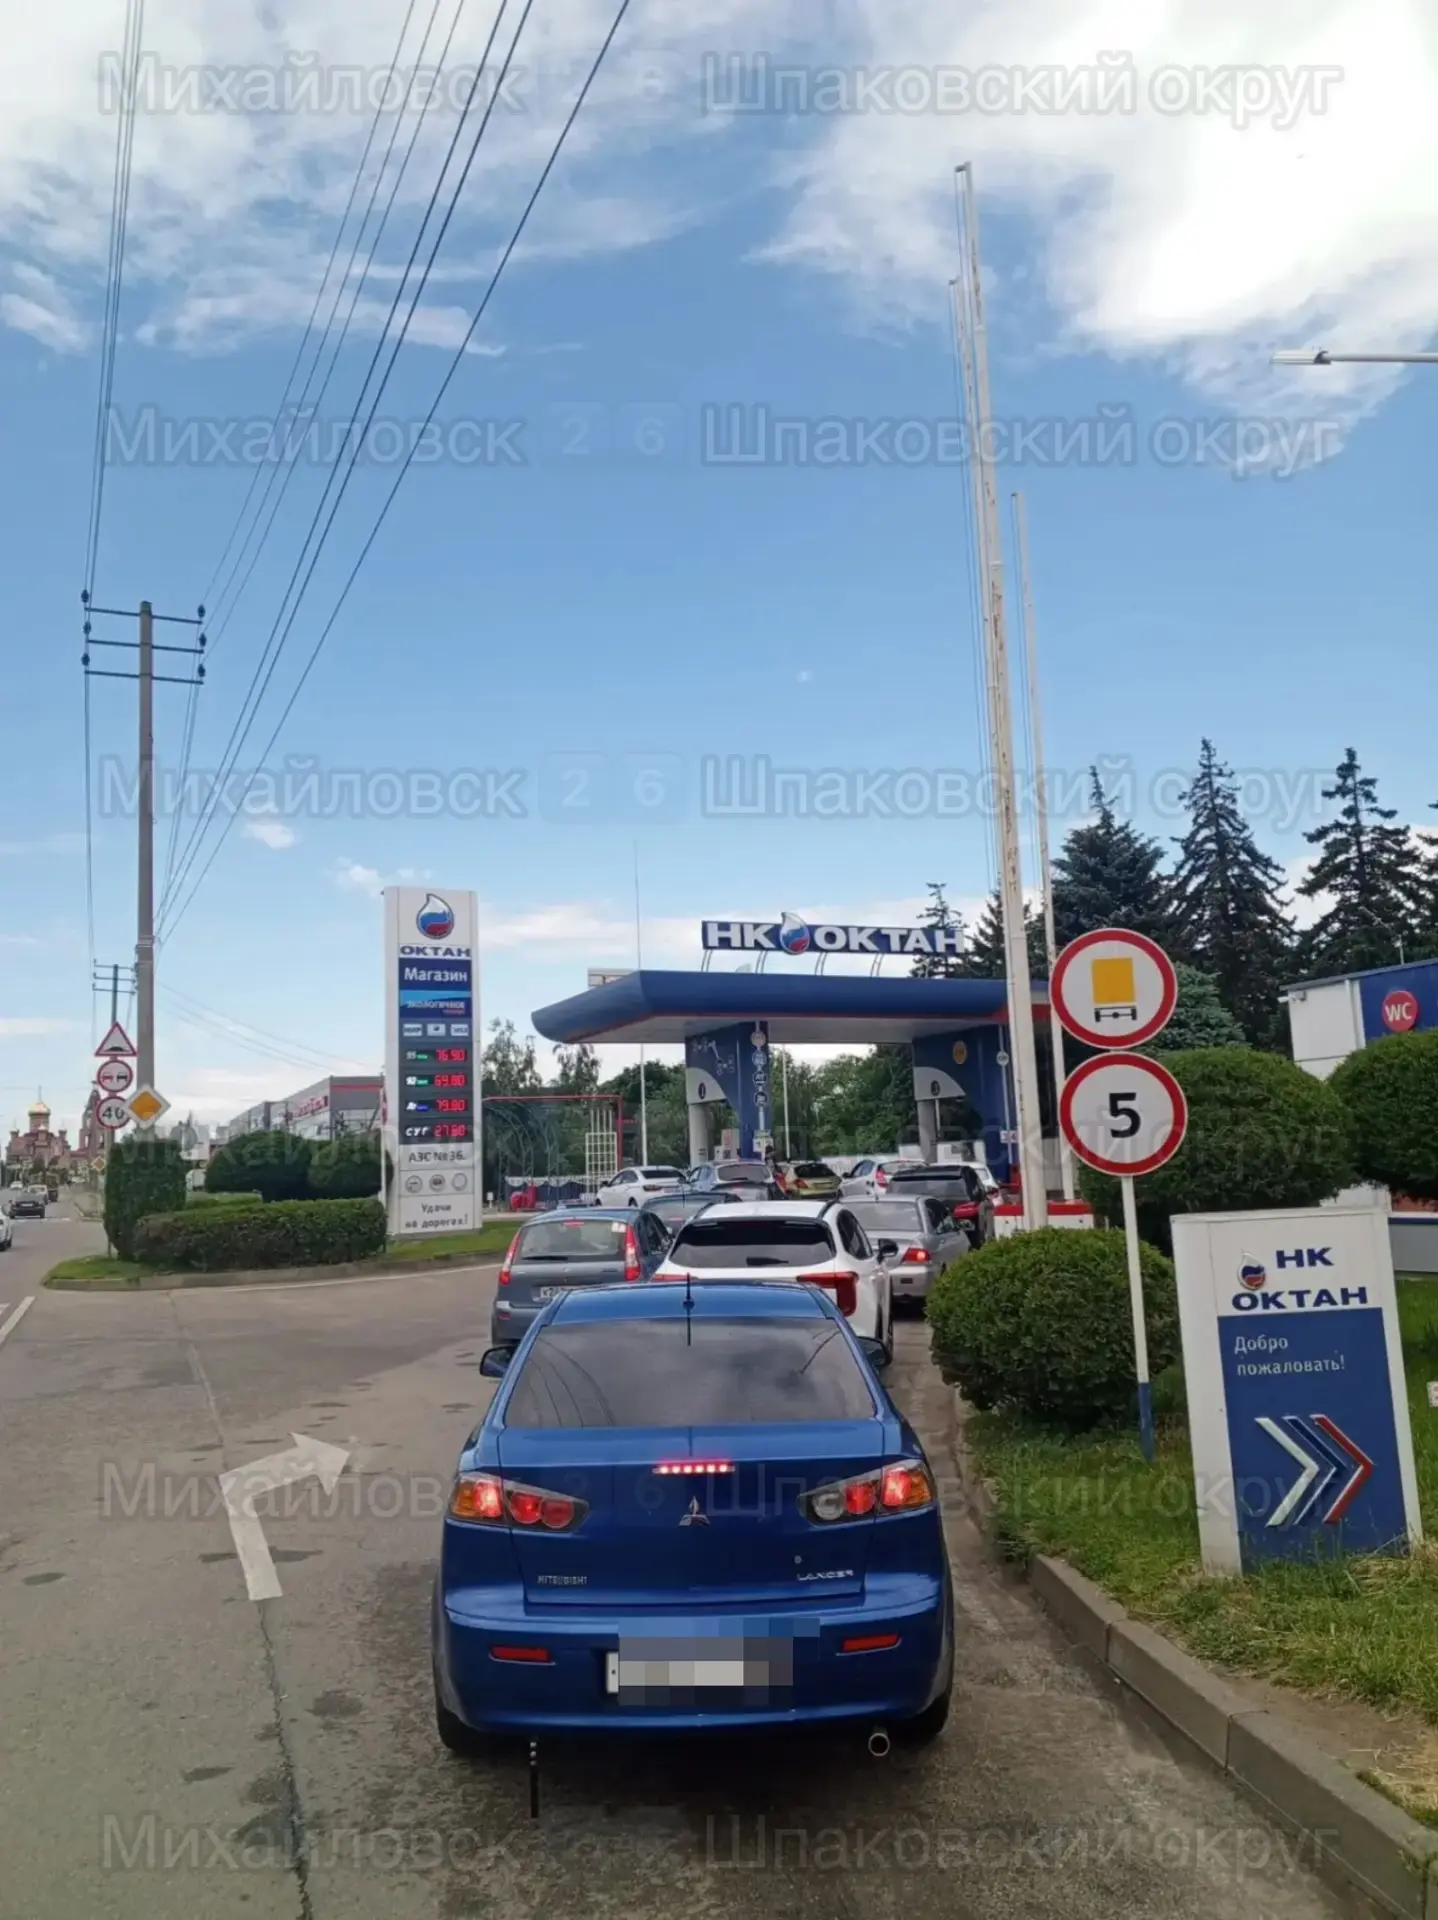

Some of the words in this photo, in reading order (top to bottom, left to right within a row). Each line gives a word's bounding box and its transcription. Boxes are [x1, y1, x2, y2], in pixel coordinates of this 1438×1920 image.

[705, 921, 776, 949] НК
[813, 925, 965, 953] ОКТАН
[401, 945, 471, 957] ОКТАН
[404, 966, 468, 982] Магазин
[1384, 1002, 1413, 1023] WC
[102, 1106, 126, 1120] 40
[1109, 1092, 1141, 1139] 5
[1275, 1247, 1335, 1269] НК
[1231, 1286, 1369, 1311] ОКТАН
[1234, 1334, 1289, 1355] Добро
[1236, 1355, 1346, 1376] пожаловать!
